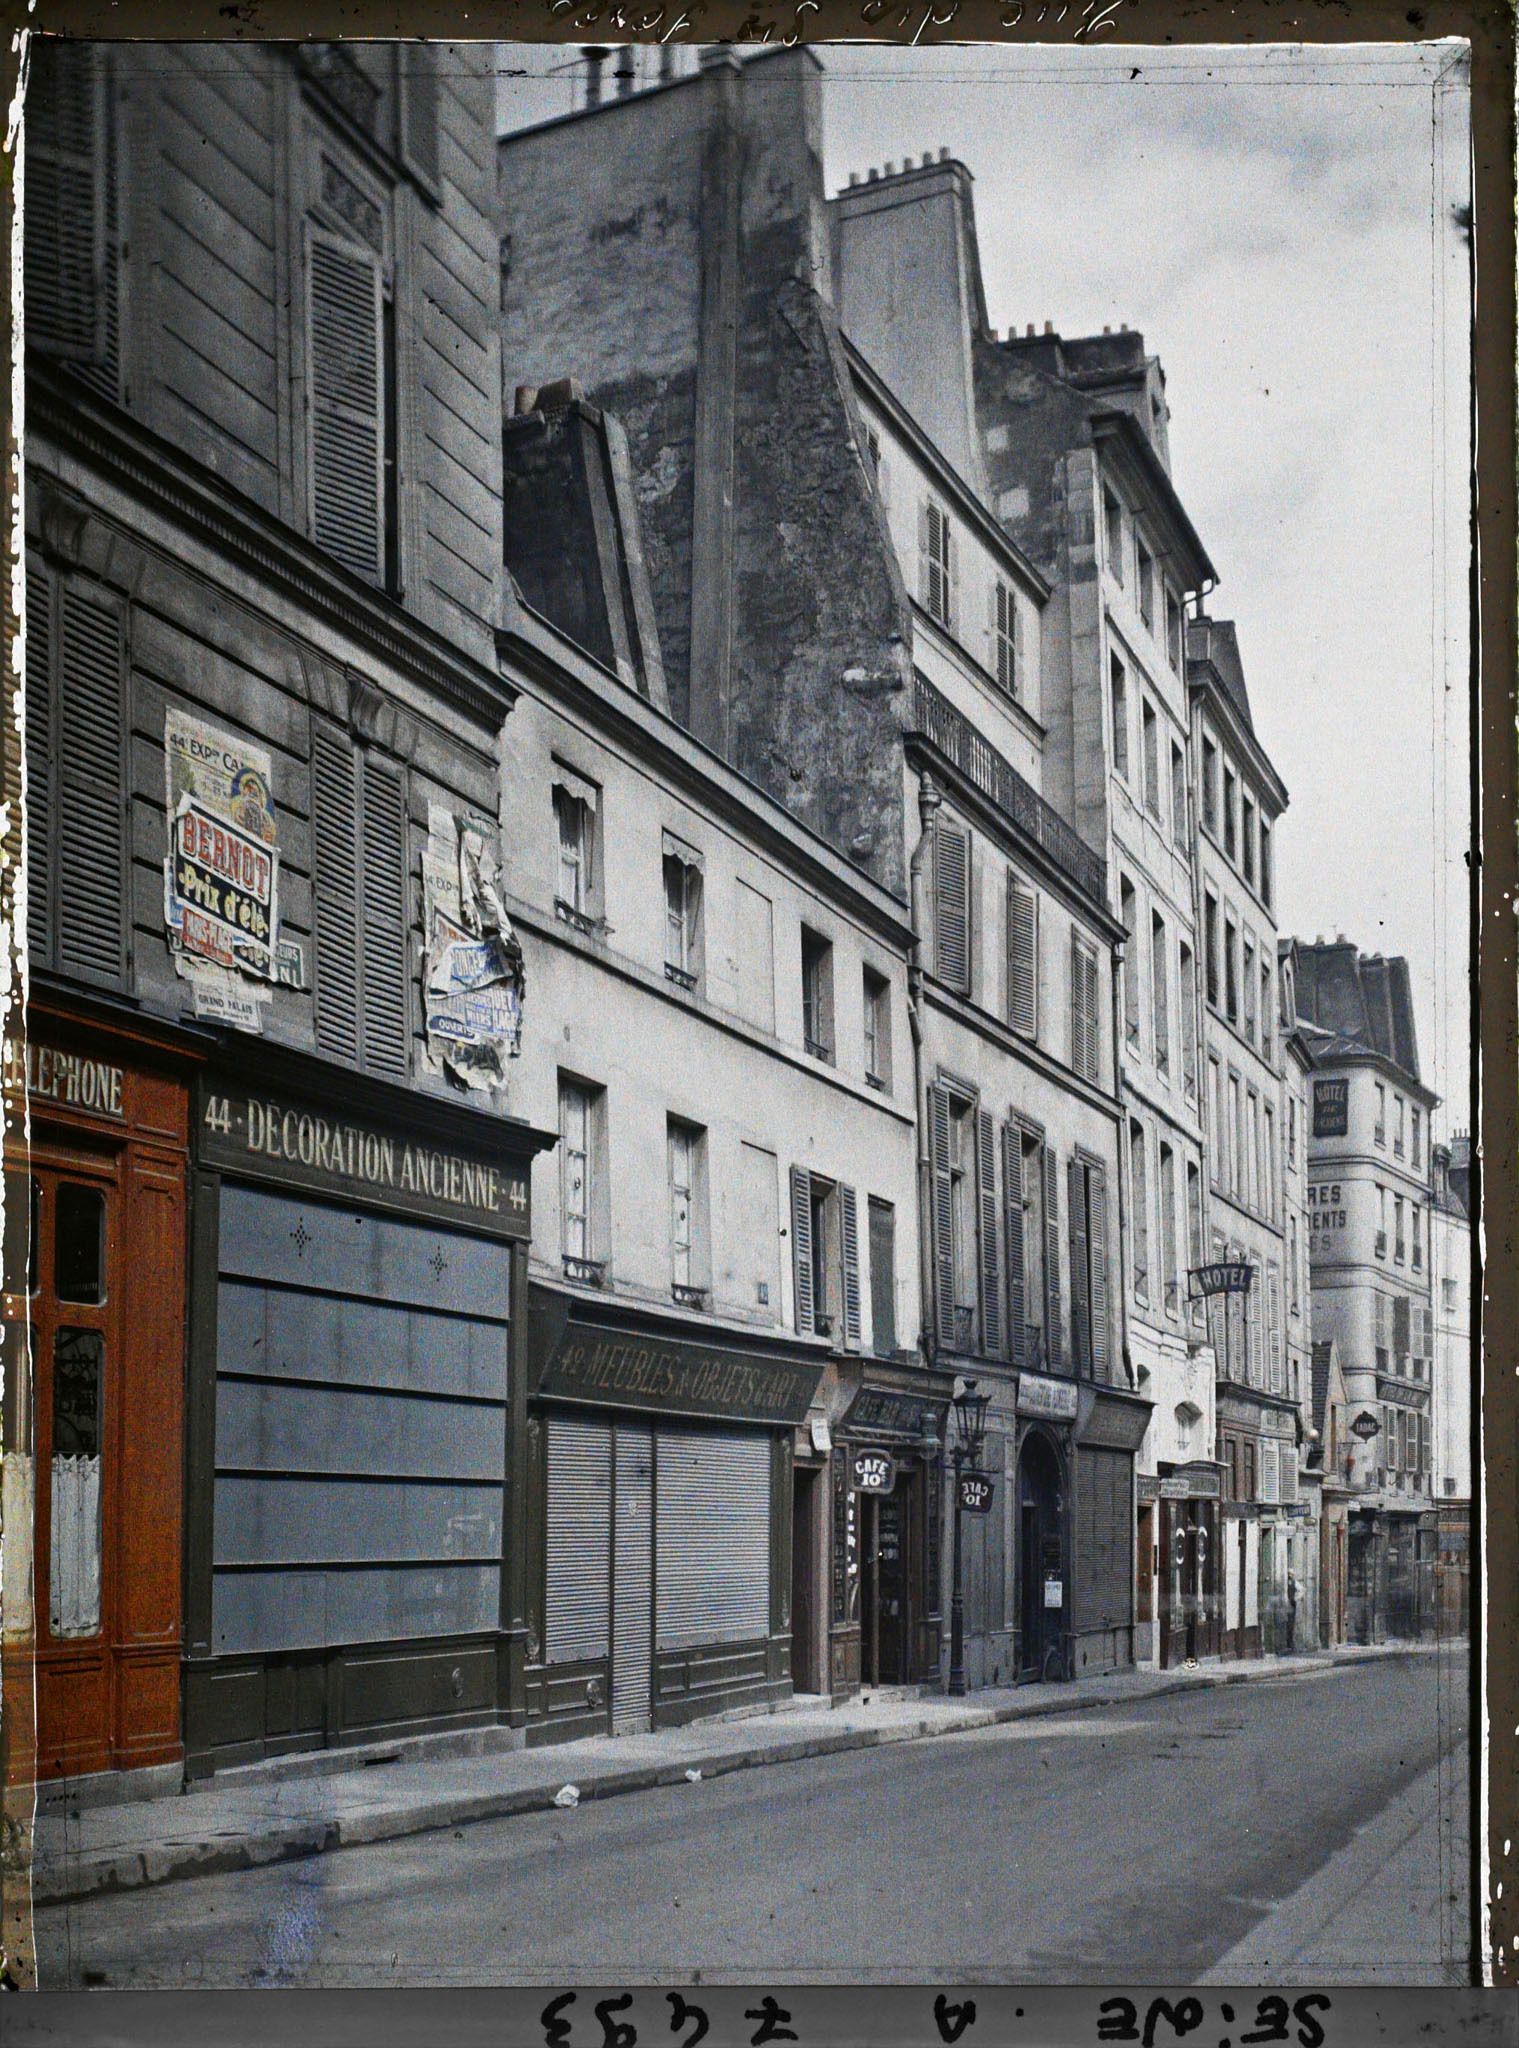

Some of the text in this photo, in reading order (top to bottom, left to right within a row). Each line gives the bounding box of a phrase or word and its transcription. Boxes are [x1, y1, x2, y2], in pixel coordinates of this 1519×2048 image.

[183, 810, 269, 900] BERNOT
[179, 861, 221, 915] Prix
[227, 1000, 253, 1015] PALAIS
[205, 1096, 231, 1134] 44
[400, 1144, 500, 1212] ANCIENNE
[509, 1180, 527, 1211] 44
[1308, 1210, 1346, 1230] ENTS
[582, 1343, 681, 1396] MEUBLES
[691, 1359, 760, 1404] OBJETS
